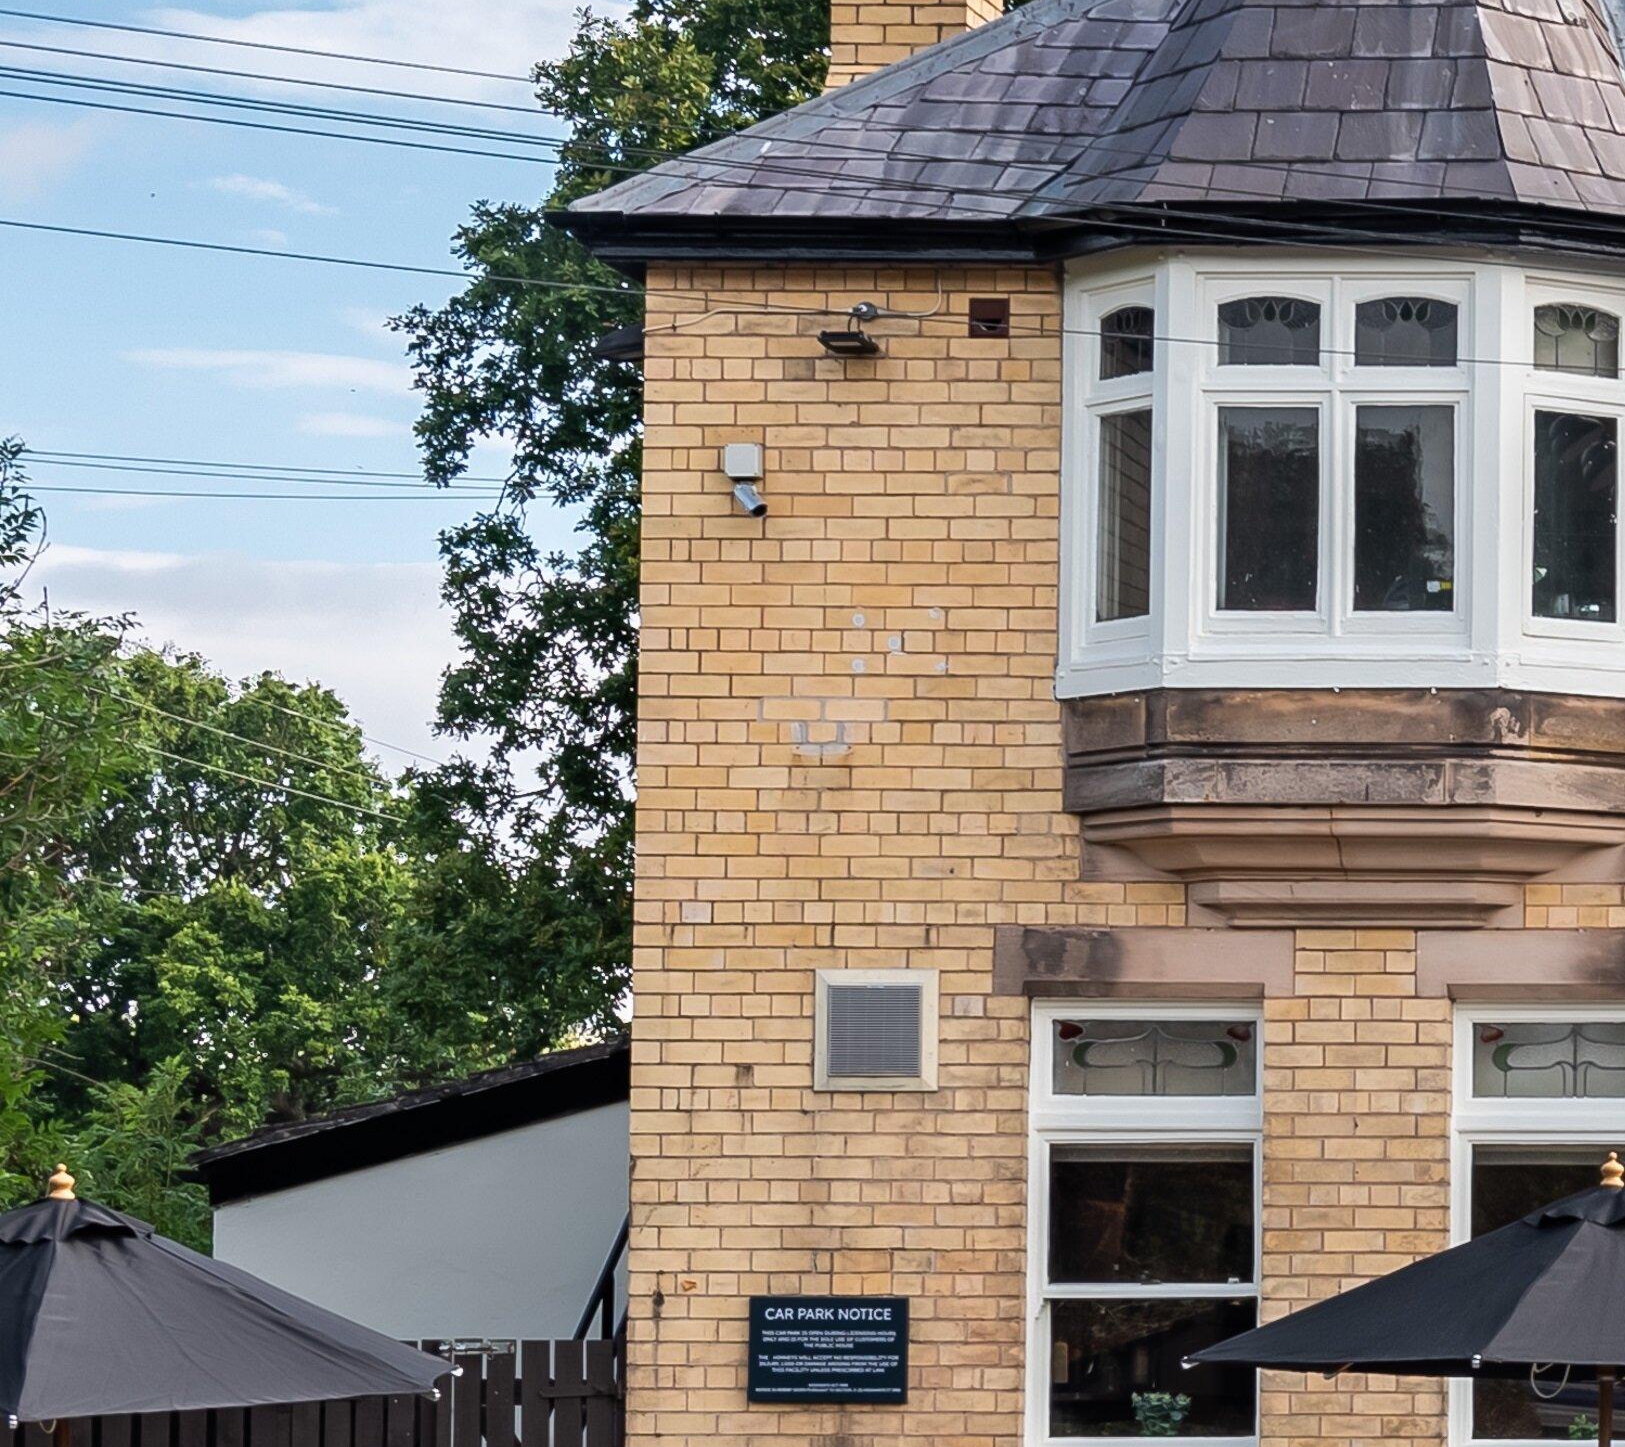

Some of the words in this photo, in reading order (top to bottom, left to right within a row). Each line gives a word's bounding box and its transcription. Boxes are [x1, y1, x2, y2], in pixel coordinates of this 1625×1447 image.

[764, 1308, 794, 1321] CAR
[797, 1308, 835, 1321] PARK
[838, 1308, 892, 1321] NOTICE
